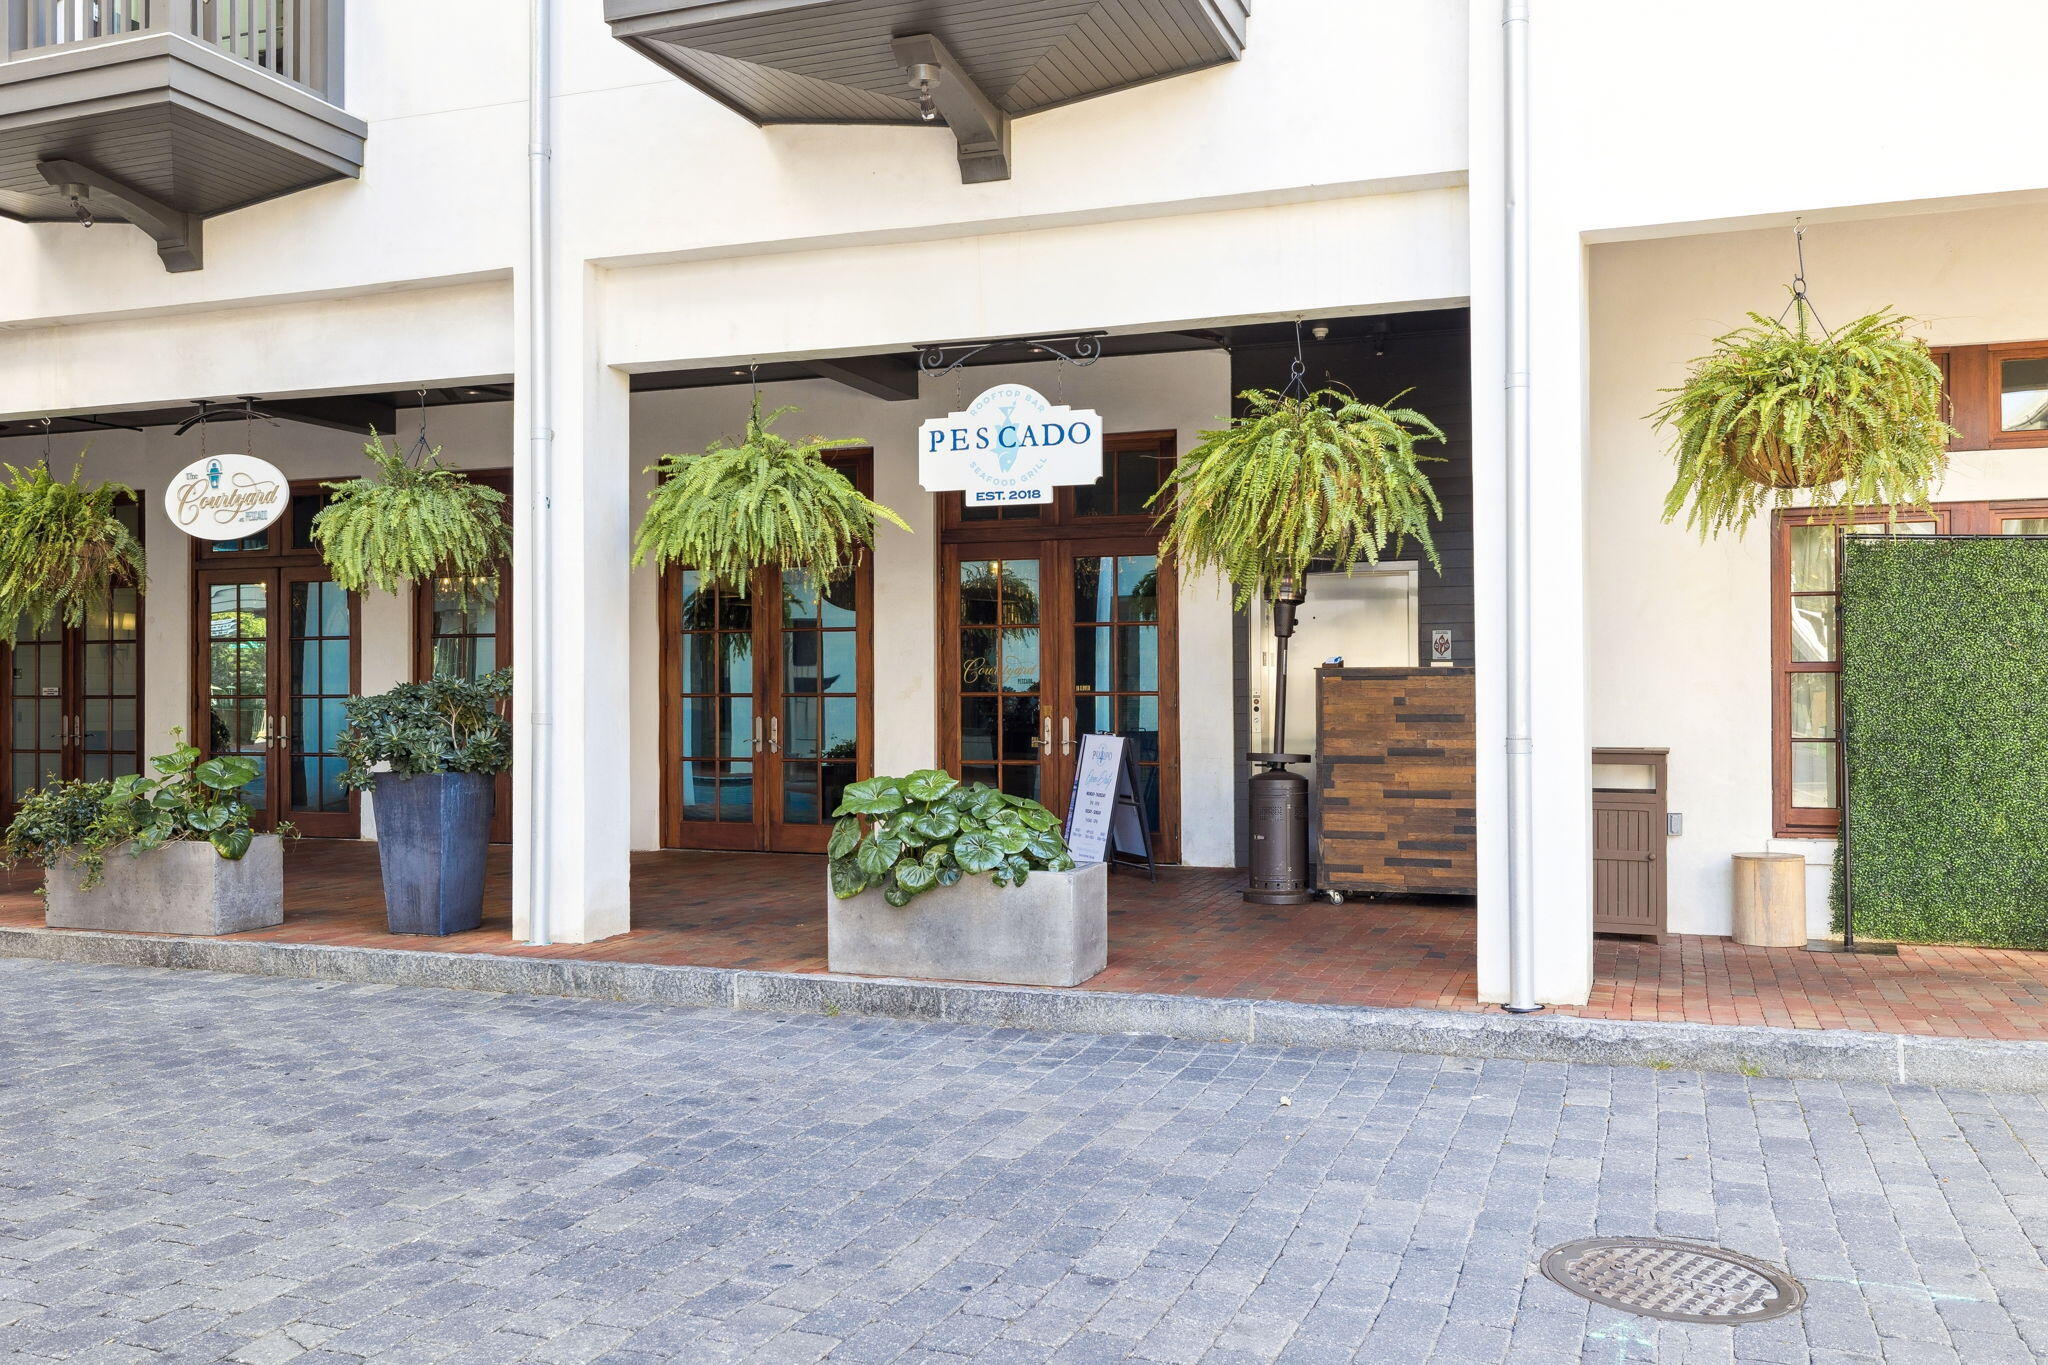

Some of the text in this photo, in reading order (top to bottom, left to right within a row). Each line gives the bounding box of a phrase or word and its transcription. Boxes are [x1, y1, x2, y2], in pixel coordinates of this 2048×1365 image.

[971, 390, 1047, 416] ROOFTOP BAR
[928, 421, 1092, 453] PESCADO
[186, 472, 199, 480] The
[968, 456, 1048, 486] SEAFOOD GRILL
[177, 472, 279, 525] Courtyard
[976, 489, 1041, 501] EST. 2018
